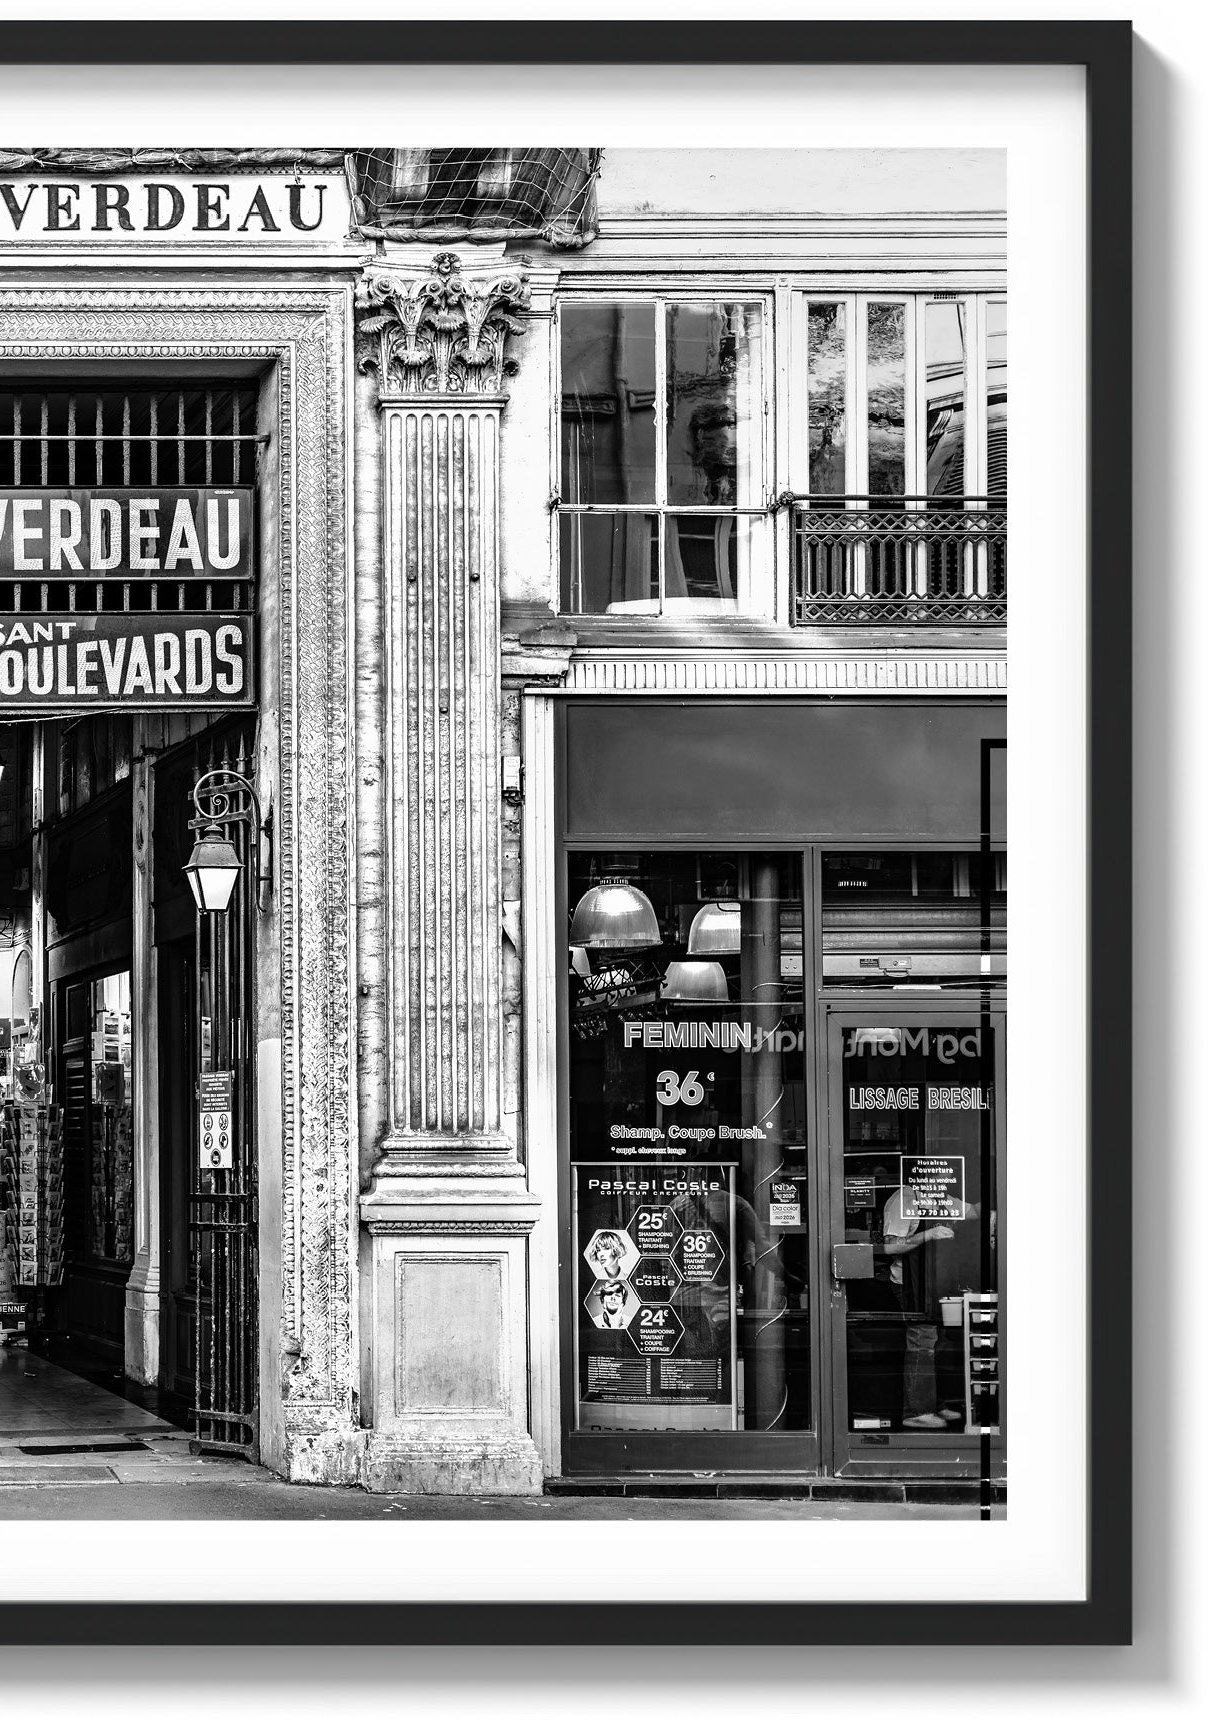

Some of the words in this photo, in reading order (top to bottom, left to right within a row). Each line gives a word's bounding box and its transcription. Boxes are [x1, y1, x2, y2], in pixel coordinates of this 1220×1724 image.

[624, 1021, 752, 1048] FEMININ
[850, 1088, 919, 1109] LISSAGE
[928, 1087, 991, 1110] BRESIL
[610, 1125, 665, 1141] Shamp.
[668, 1125, 716, 1141] Coupe
[588, 1180, 656, 1190] Pascal
[663, 1180, 720, 1190] Coste
[635, 1279, 676, 1287] Coste
